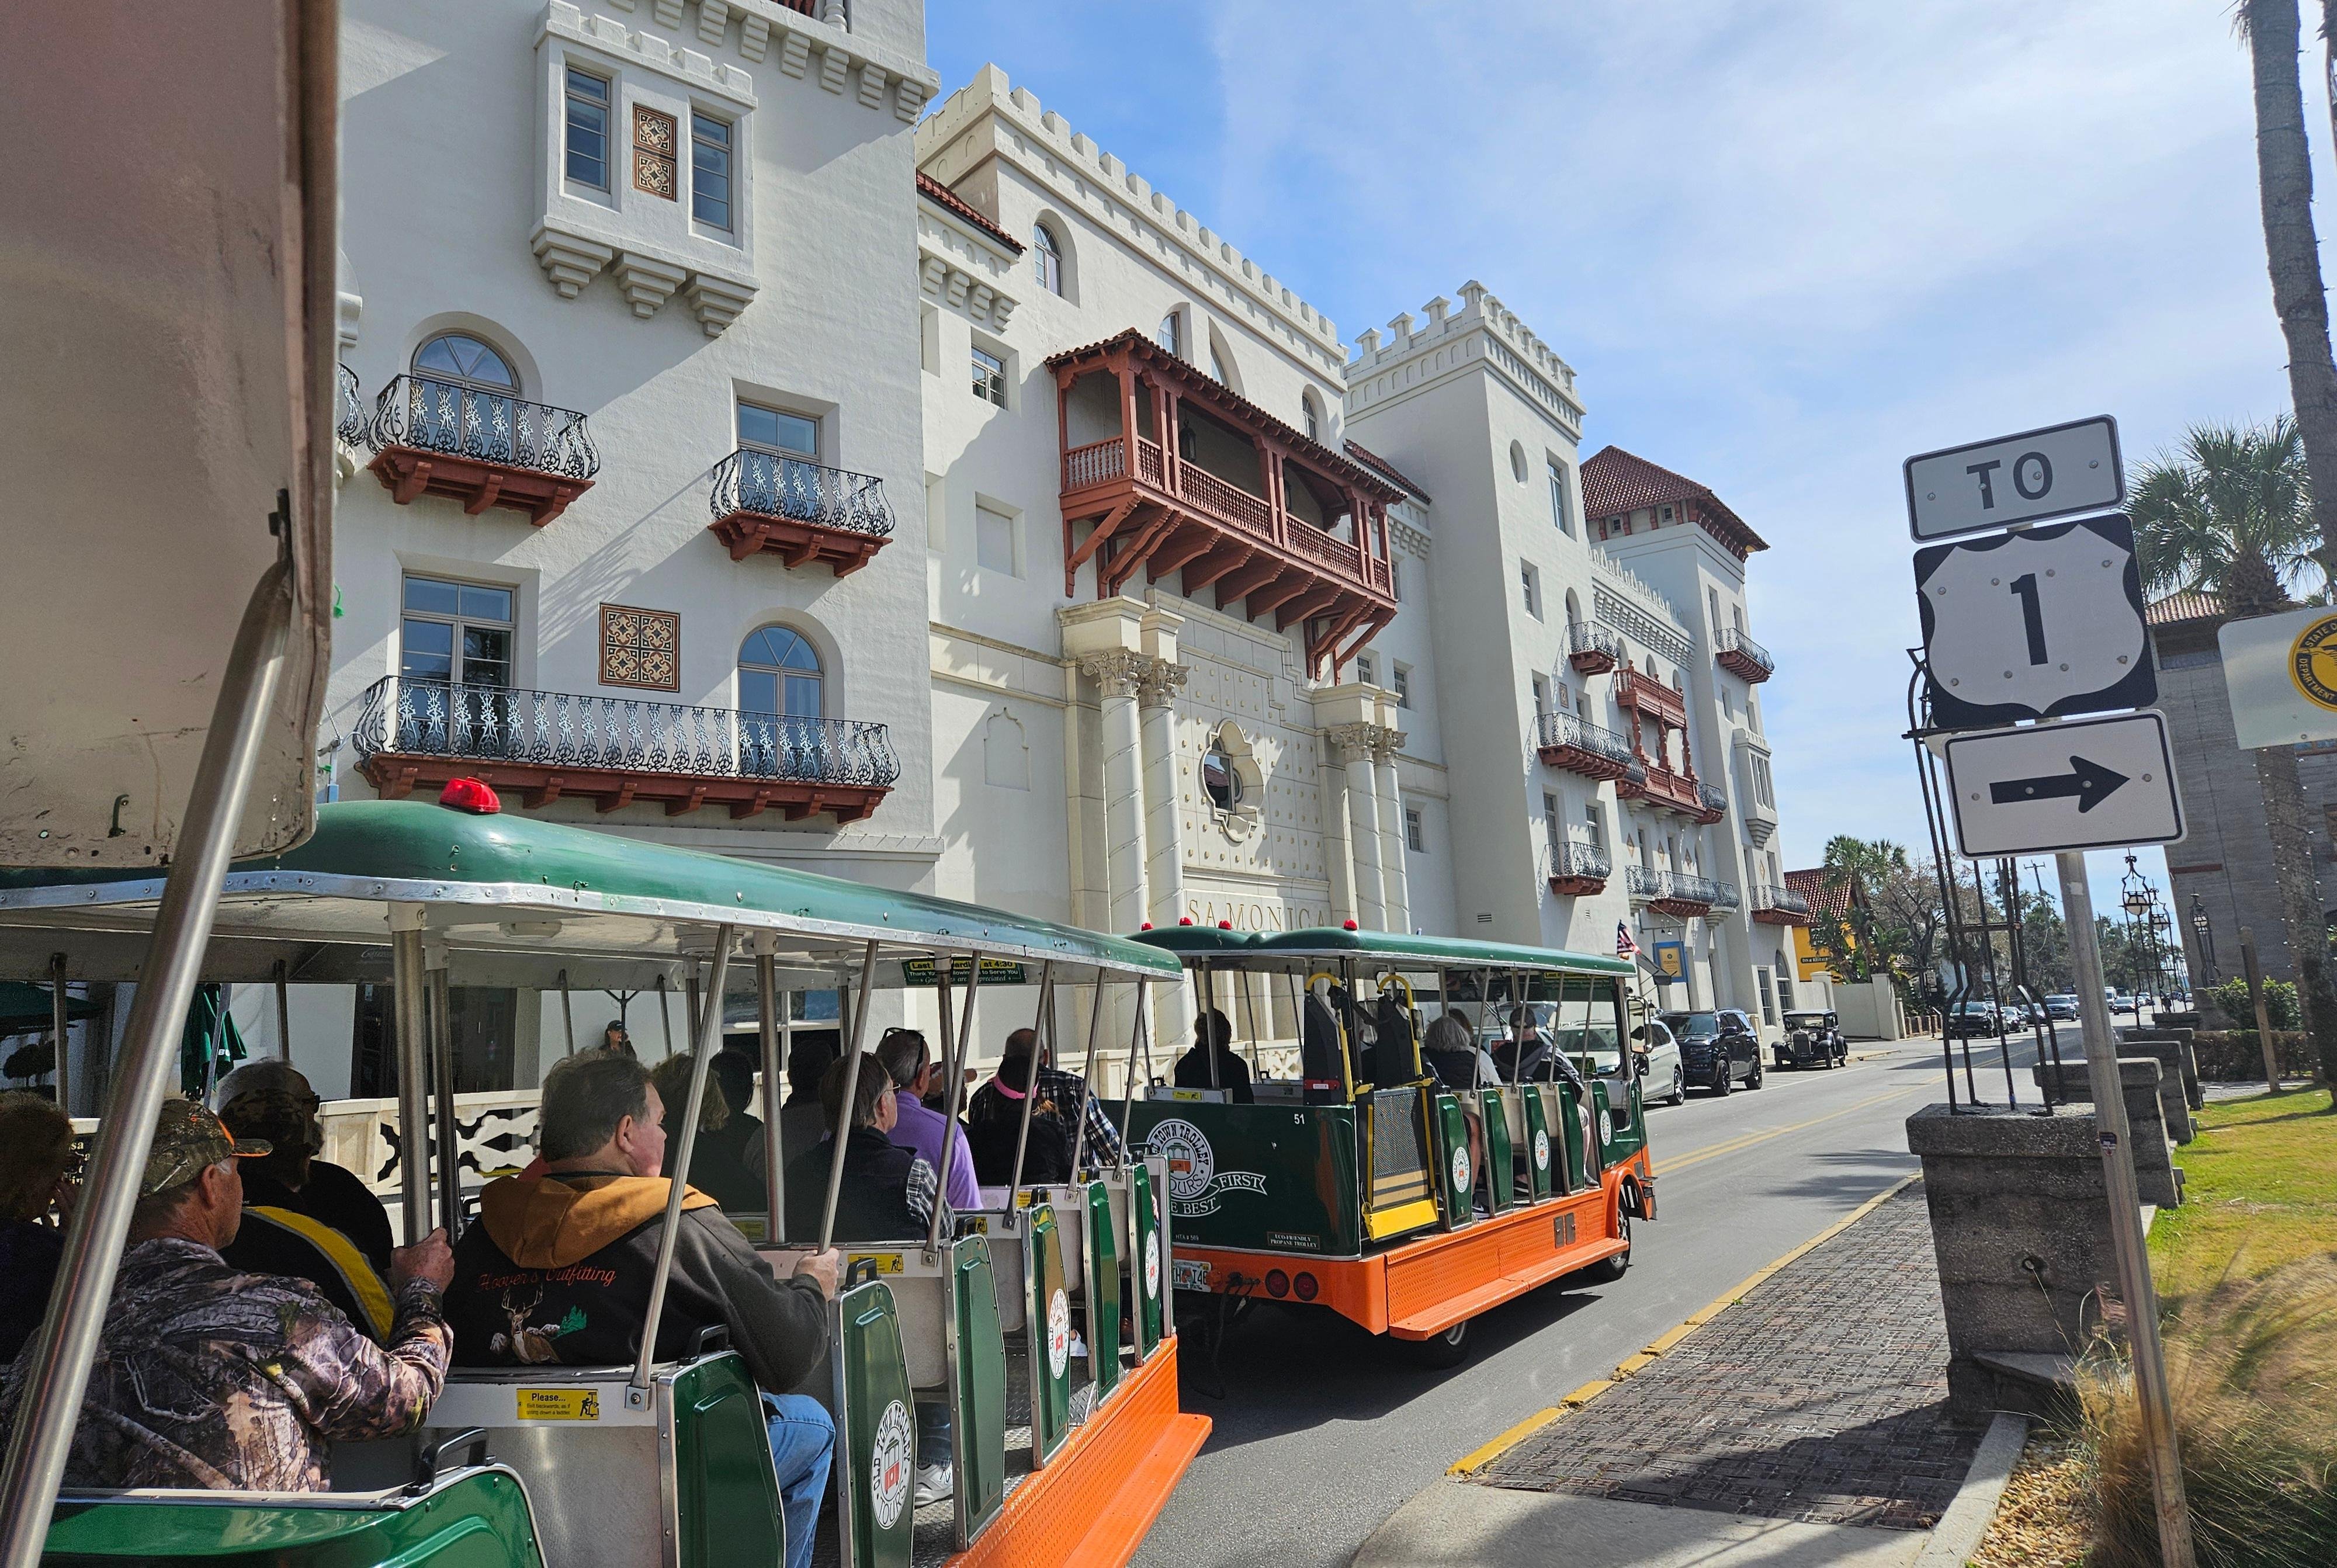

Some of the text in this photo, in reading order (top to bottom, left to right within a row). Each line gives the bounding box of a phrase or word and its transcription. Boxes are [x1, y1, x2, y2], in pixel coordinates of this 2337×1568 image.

[1966, 452, 2053, 510] TO
[2010, 573, 2048, 665] 1
[2305, 622, 2337, 647] STATE O
[2299, 658, 2335, 700] DEPARTMENT
[1294, 1113, 1305, 1125] 51
[1154, 1124, 1177, 1145] TOWN
[1180, 1125, 1209, 1165] TROLLEY
[1170, 1174, 1203, 1194] OURS
[1218, 1174, 1261, 1188] FIRST
[1183, 1197, 1216, 1214] BEST
[1275, 1234, 1311, 1242] ECO-FRIENDLY
[479, 1261, 617, 1290] Hoovers Outfitting
[532, 1393, 566, 1402] Please...
[876, 1409, 892, 1451] TOWN
[894, 1404, 910, 1462] TROLLEY
[879, 1480, 906, 1525] TOURS
